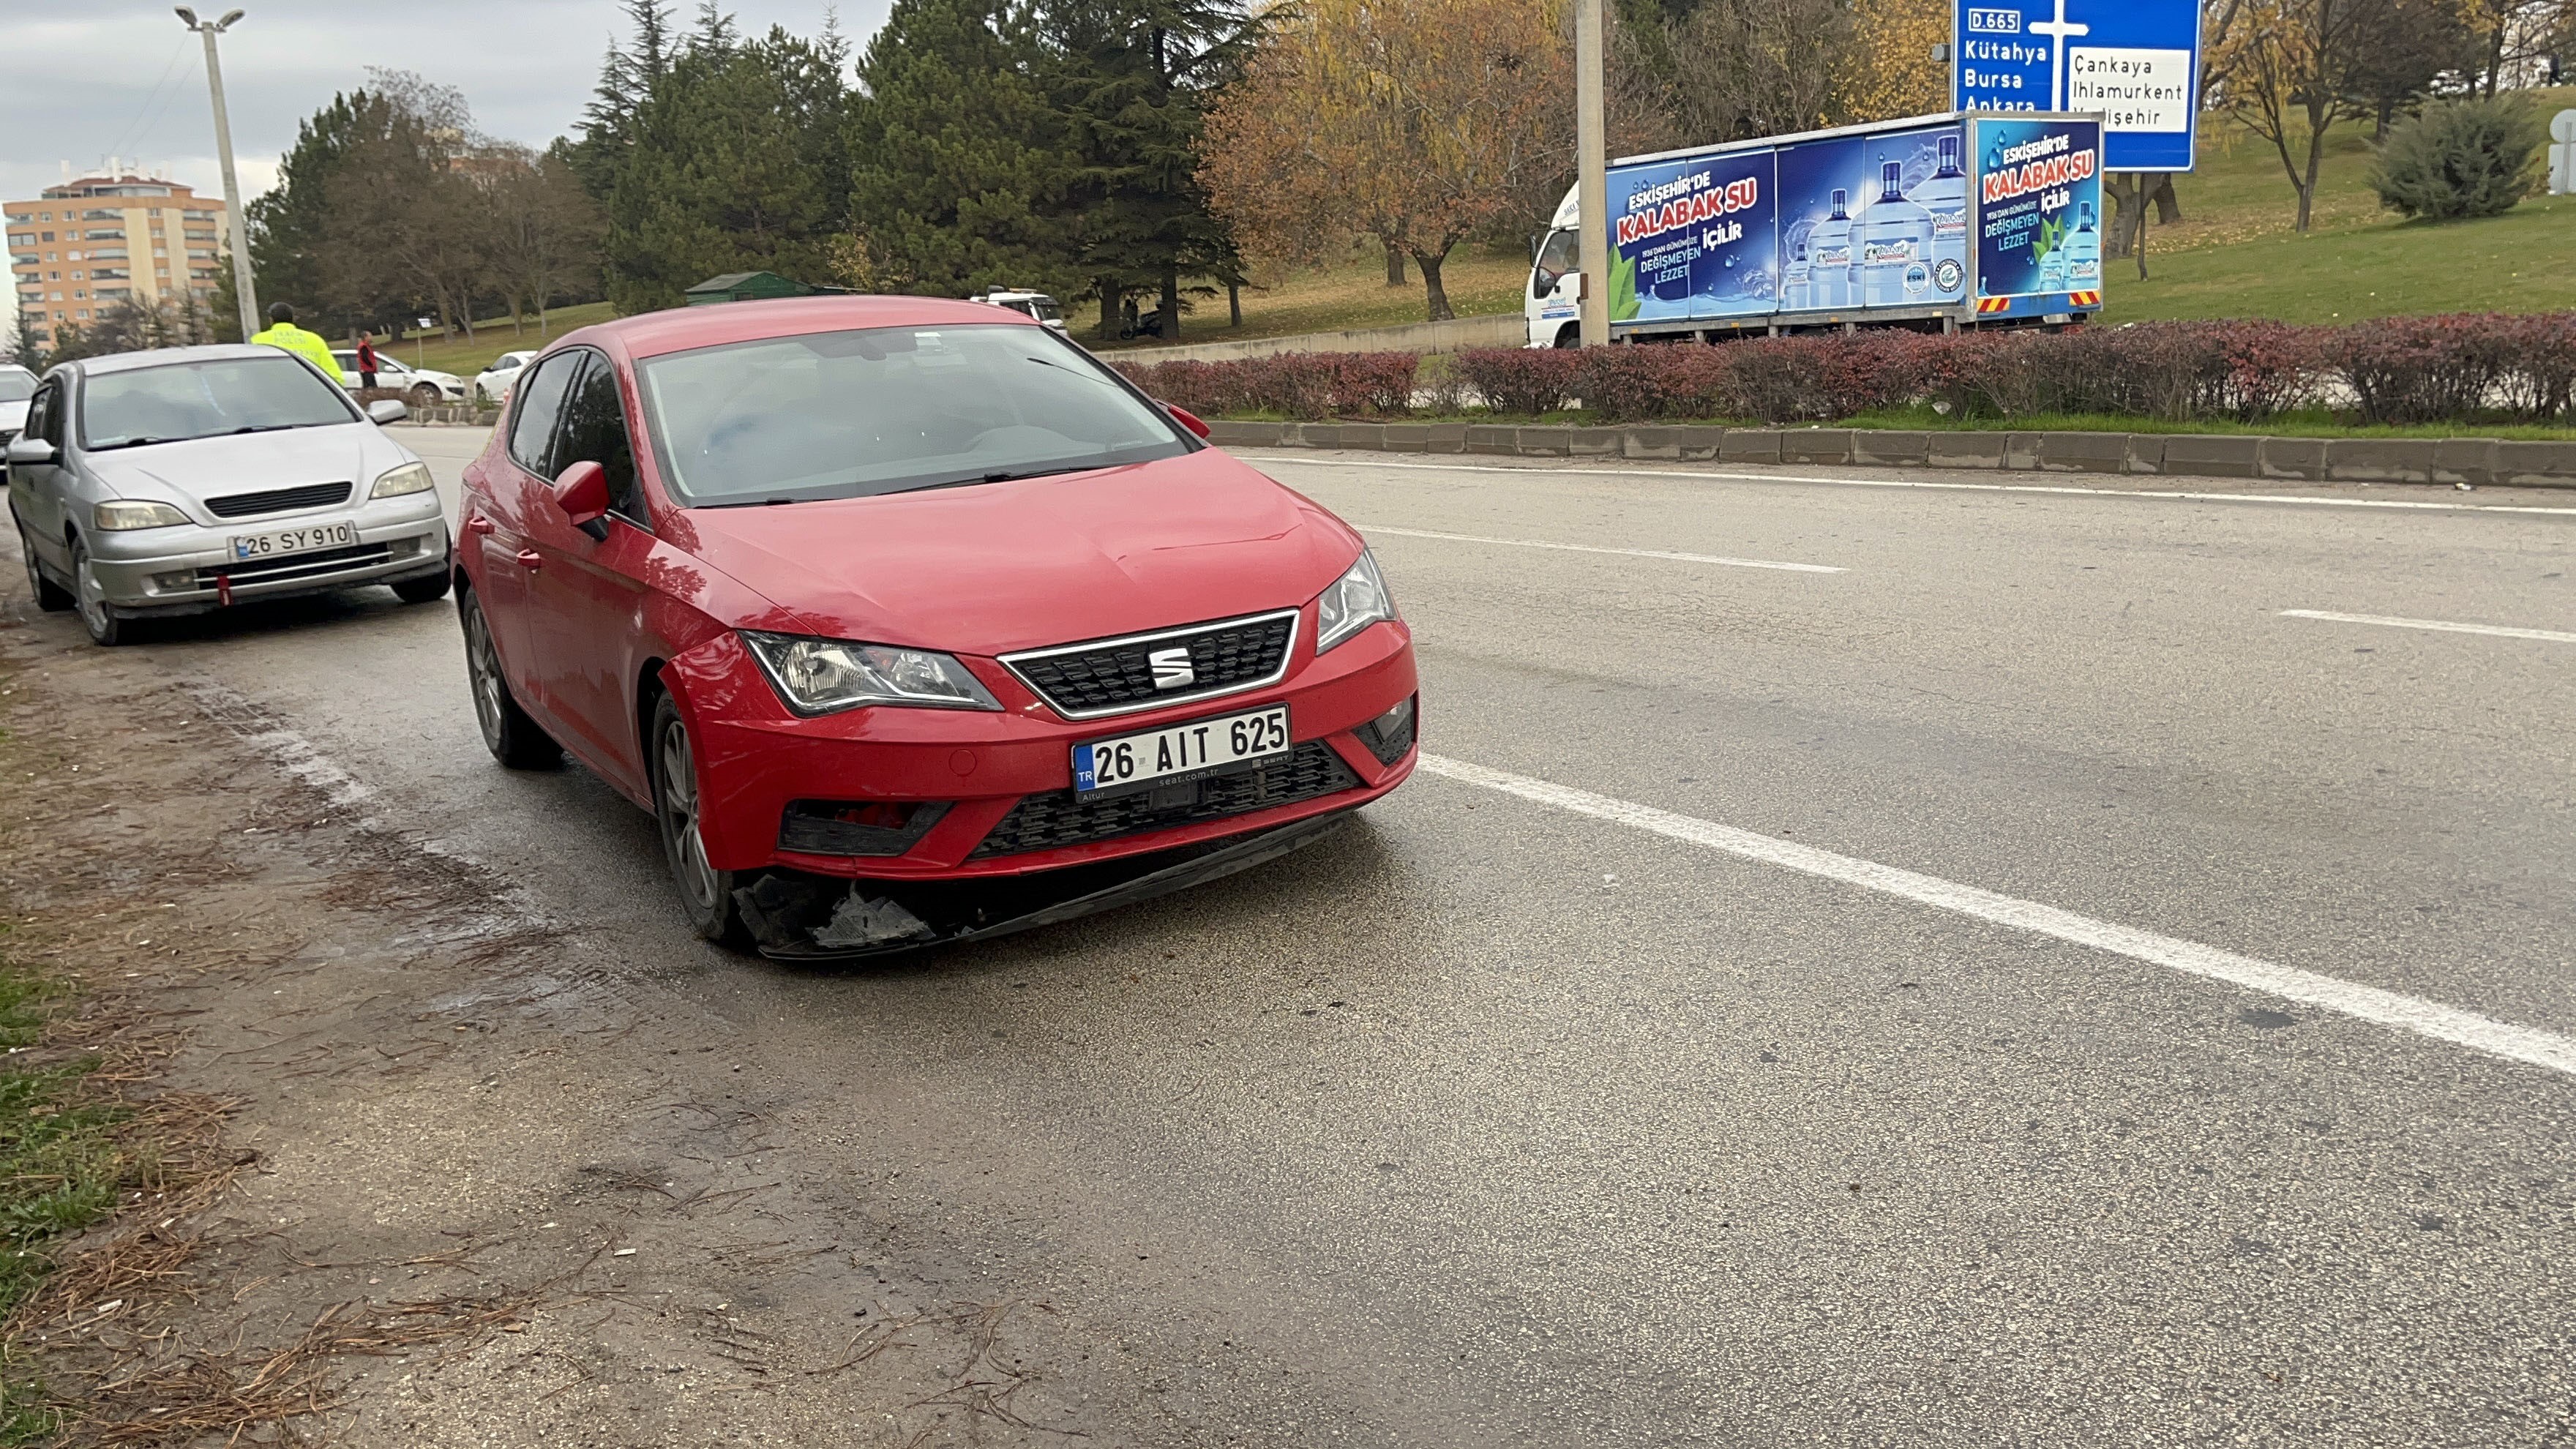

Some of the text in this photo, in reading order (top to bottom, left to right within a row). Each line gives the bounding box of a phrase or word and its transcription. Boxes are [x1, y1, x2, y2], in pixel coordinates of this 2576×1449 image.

[1966, 40, 2046, 65] Kütahya
[2075, 55, 2152, 77] Çankaya
[1965, 70, 2021, 89] Bursa
[2073, 81, 2182, 100] Ihlamurkent
[1965, 95, 2034, 112] Ankara
[2074, 107, 2160, 126] işehir
[2003, 134, 2069, 165] ESKİŞEHİR'DE
[1982, 149, 2094, 205] KALABAK SU
[1629, 171, 1711, 210] ESKİŞEHİR'DE
[2041, 187, 2070, 215] İÇİLİR
[1616, 176, 1757, 247] KALABAK SU
[1702, 220, 1742, 252] İÇİLİR
[1985, 211, 2040, 239] DEĞİŞMEYEN
[1998, 231, 2030, 252] LEZZET
[1641, 245, 1701, 274] DEĞİŞMEYEN
[1655, 263, 1690, 285] LEZZET
[247, 525, 348, 554] 26 SY 910
[1095, 712, 1285, 784] 26 AIT 625
[1077, 771, 1093, 782] TR
[1159, 768, 1218, 787] seat.com.tr
[1082, 790, 1106, 802] Altur
